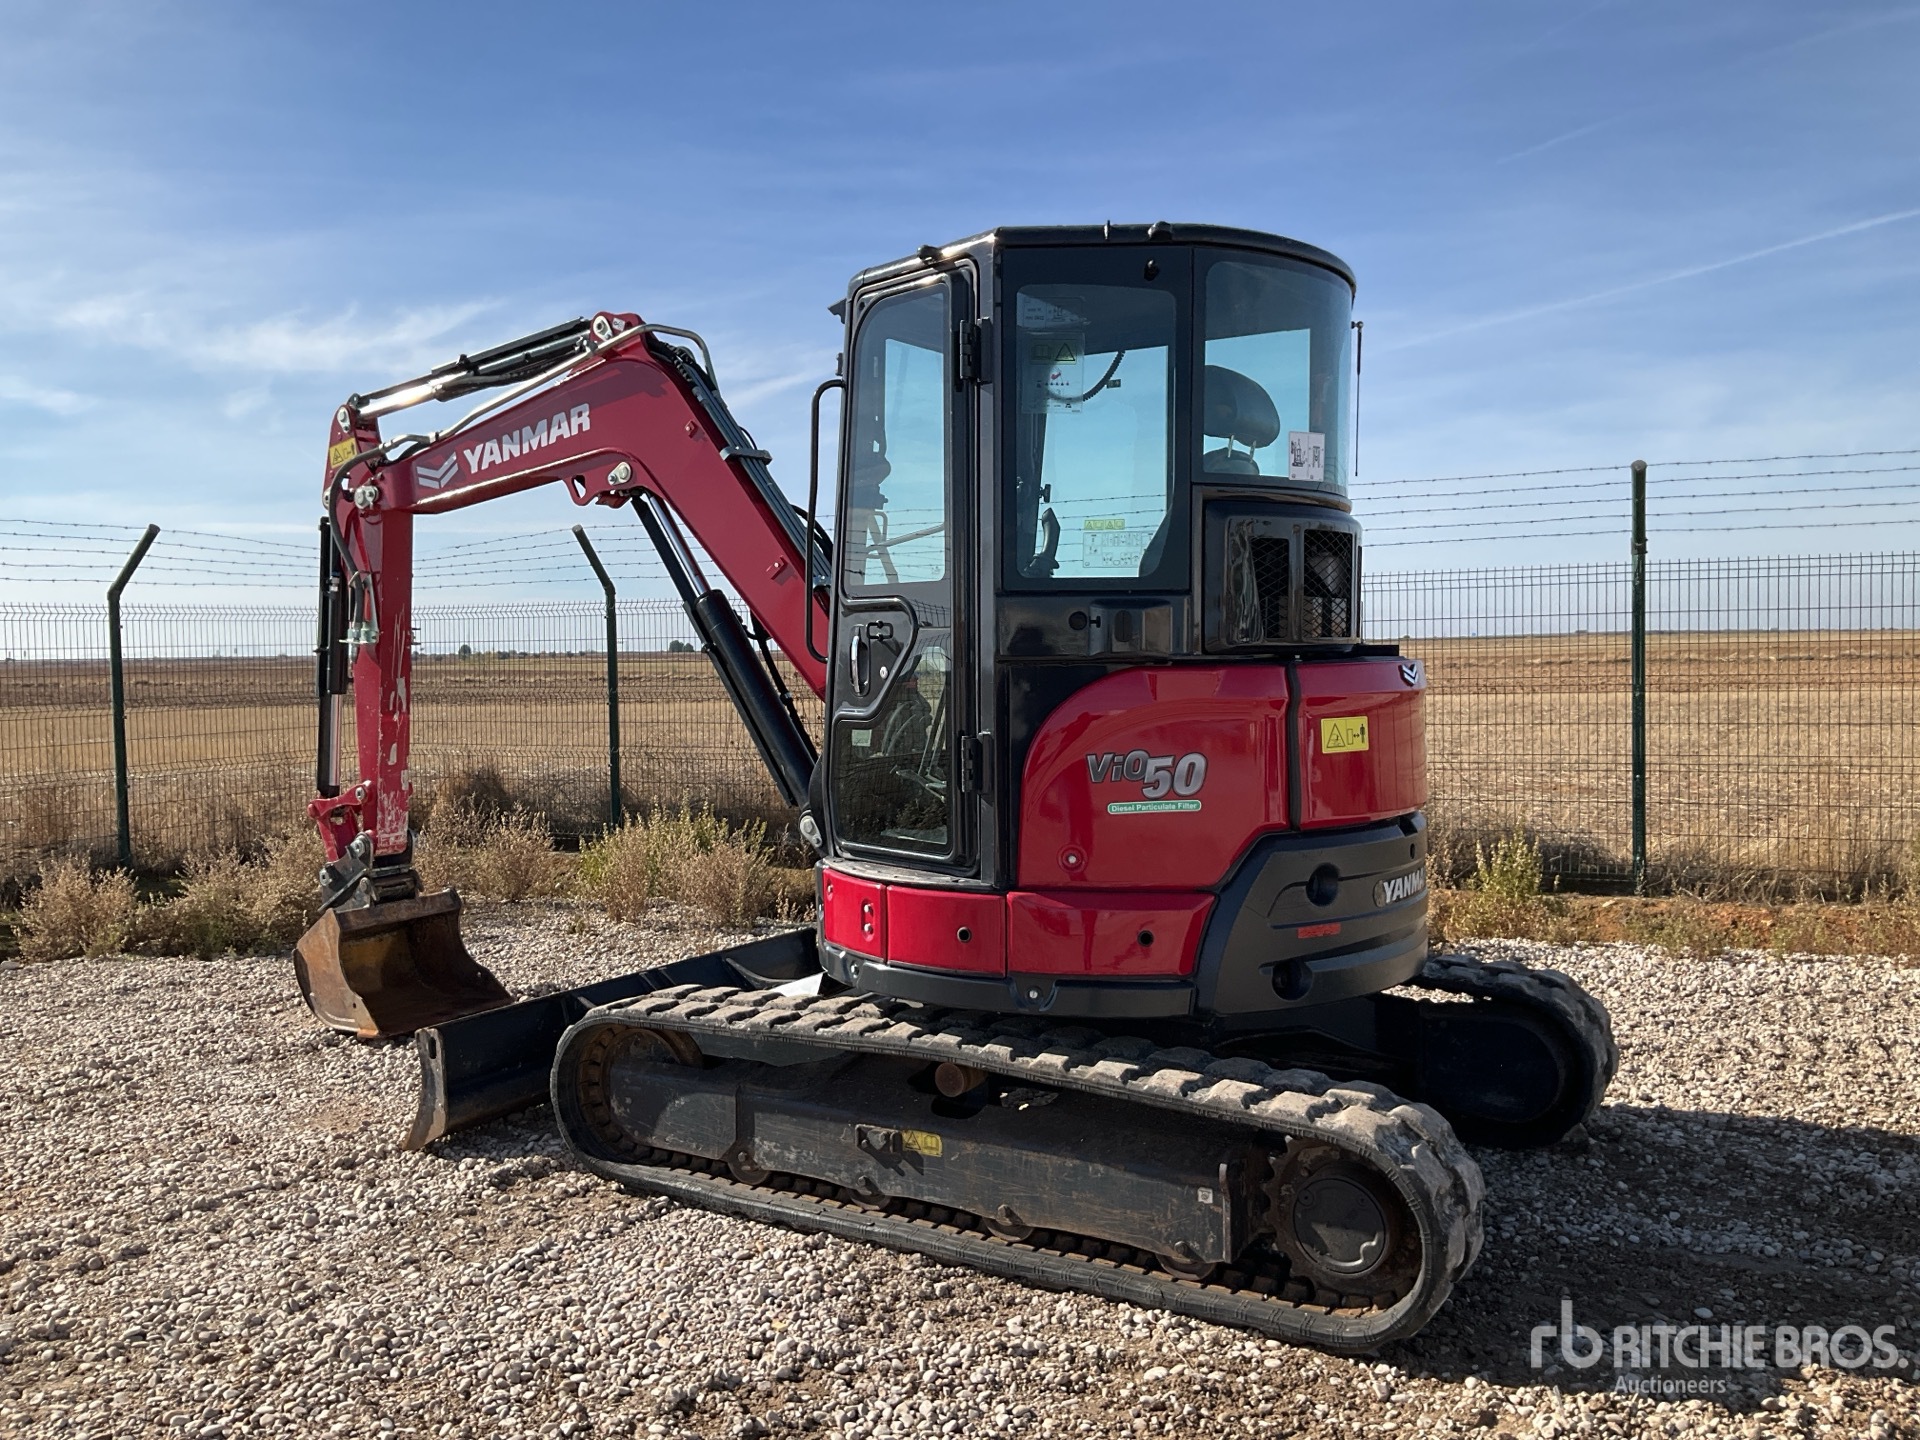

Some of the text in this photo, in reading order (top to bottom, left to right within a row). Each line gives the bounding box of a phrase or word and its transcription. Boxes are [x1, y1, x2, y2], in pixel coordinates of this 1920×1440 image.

[463, 403, 591, 475] YANMAR
[1111, 802, 1198, 812] Diesel Particulate Filter
